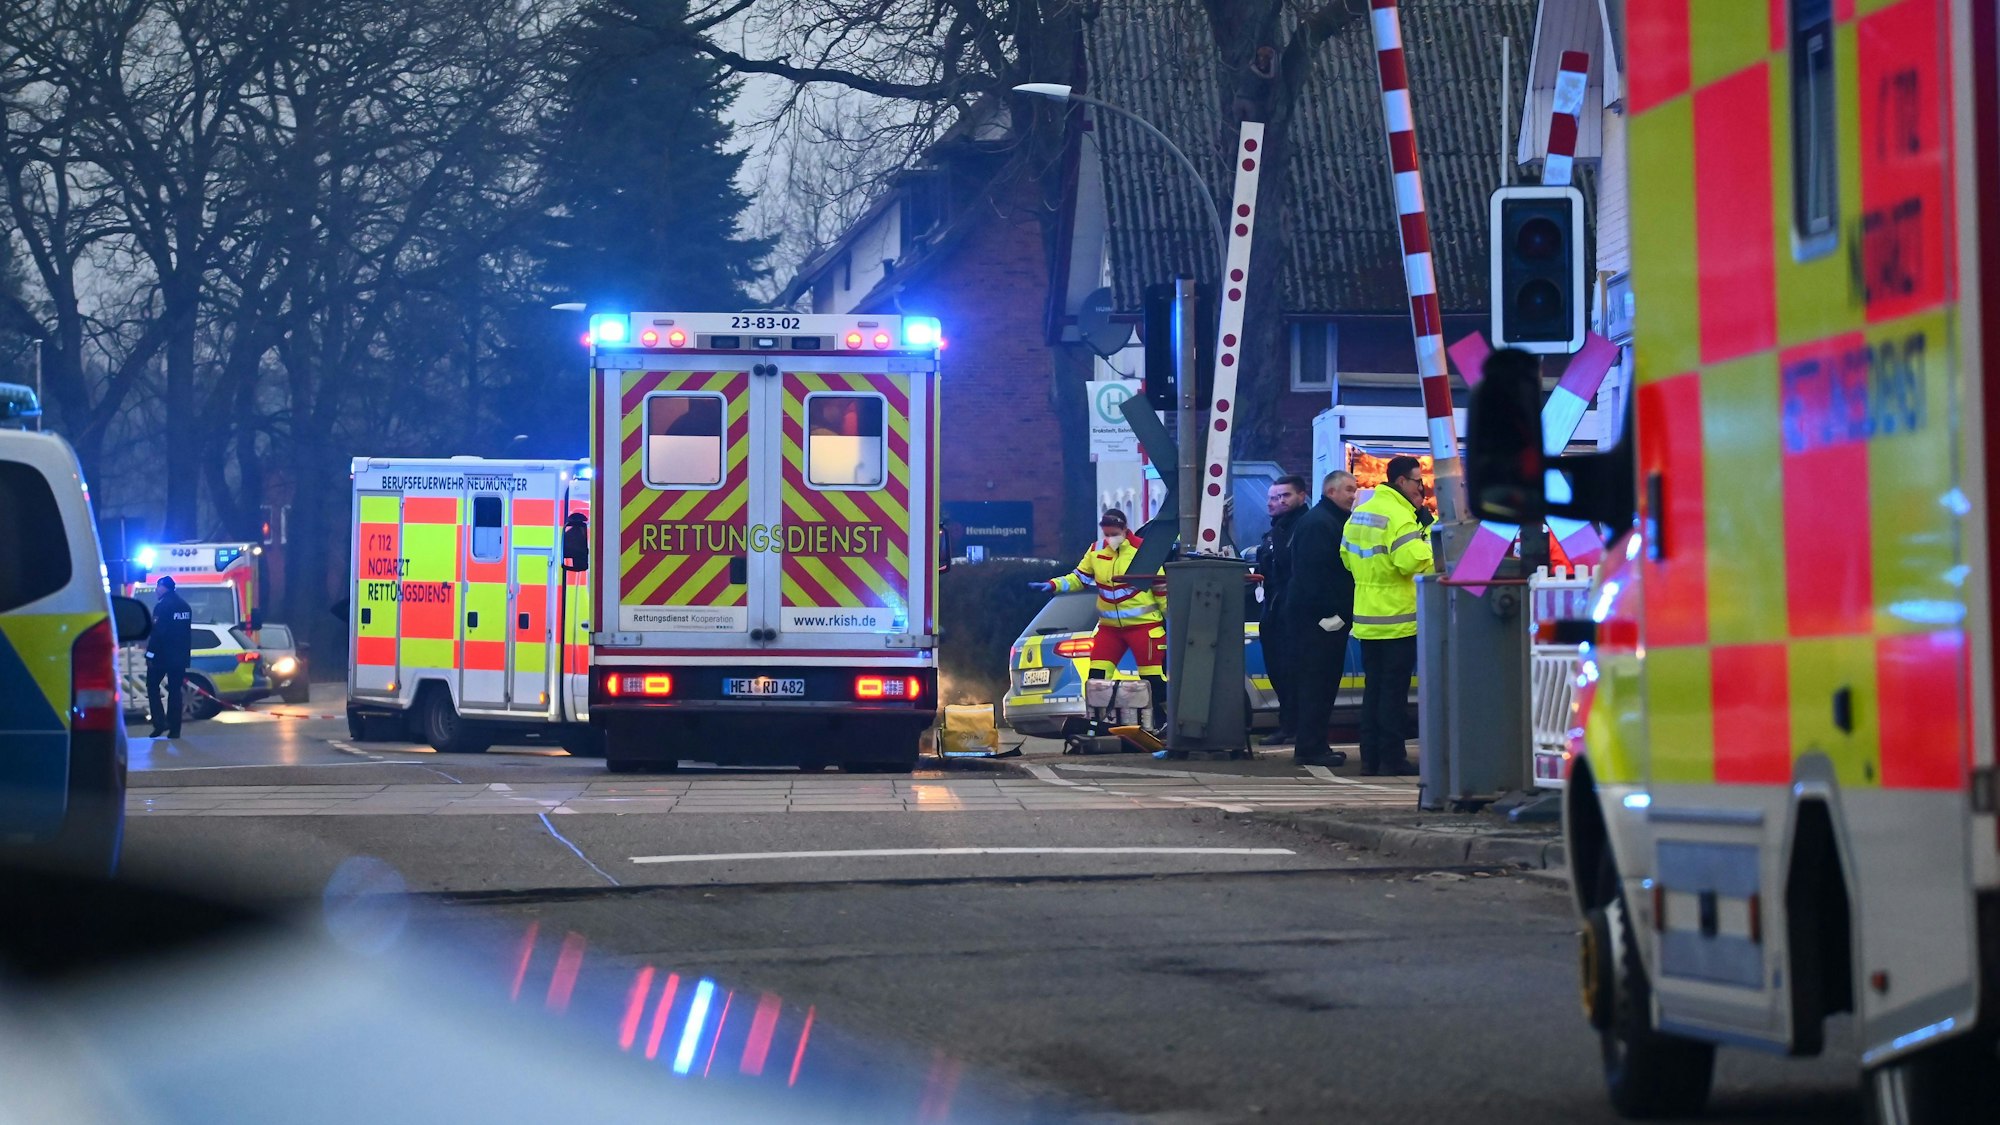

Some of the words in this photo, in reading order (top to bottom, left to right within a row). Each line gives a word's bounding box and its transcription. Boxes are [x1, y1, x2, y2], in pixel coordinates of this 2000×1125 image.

[731, 316, 800, 329] 23-83-02
[382, 475, 464, 490] BERUFSFEUERWEHR
[467, 476, 527, 491] NEUMÜNSTER
[642, 523, 883, 553] RETTUNGSDIENST
[965, 525, 1027, 537] Henningsen
[378, 534, 392, 551] 112
[368, 558, 411, 577] NOTARZT
[368, 581, 451, 604] RETTUNGSDIENST
[633, 614, 689, 623] Rettungsdienst
[690, 615, 734, 623] Kooperation
[793, 614, 876, 627] www.rkish.de
[730, 680, 753, 693] HEI
[763, 680, 778, 694] RD
[781, 680, 804, 694] 482
